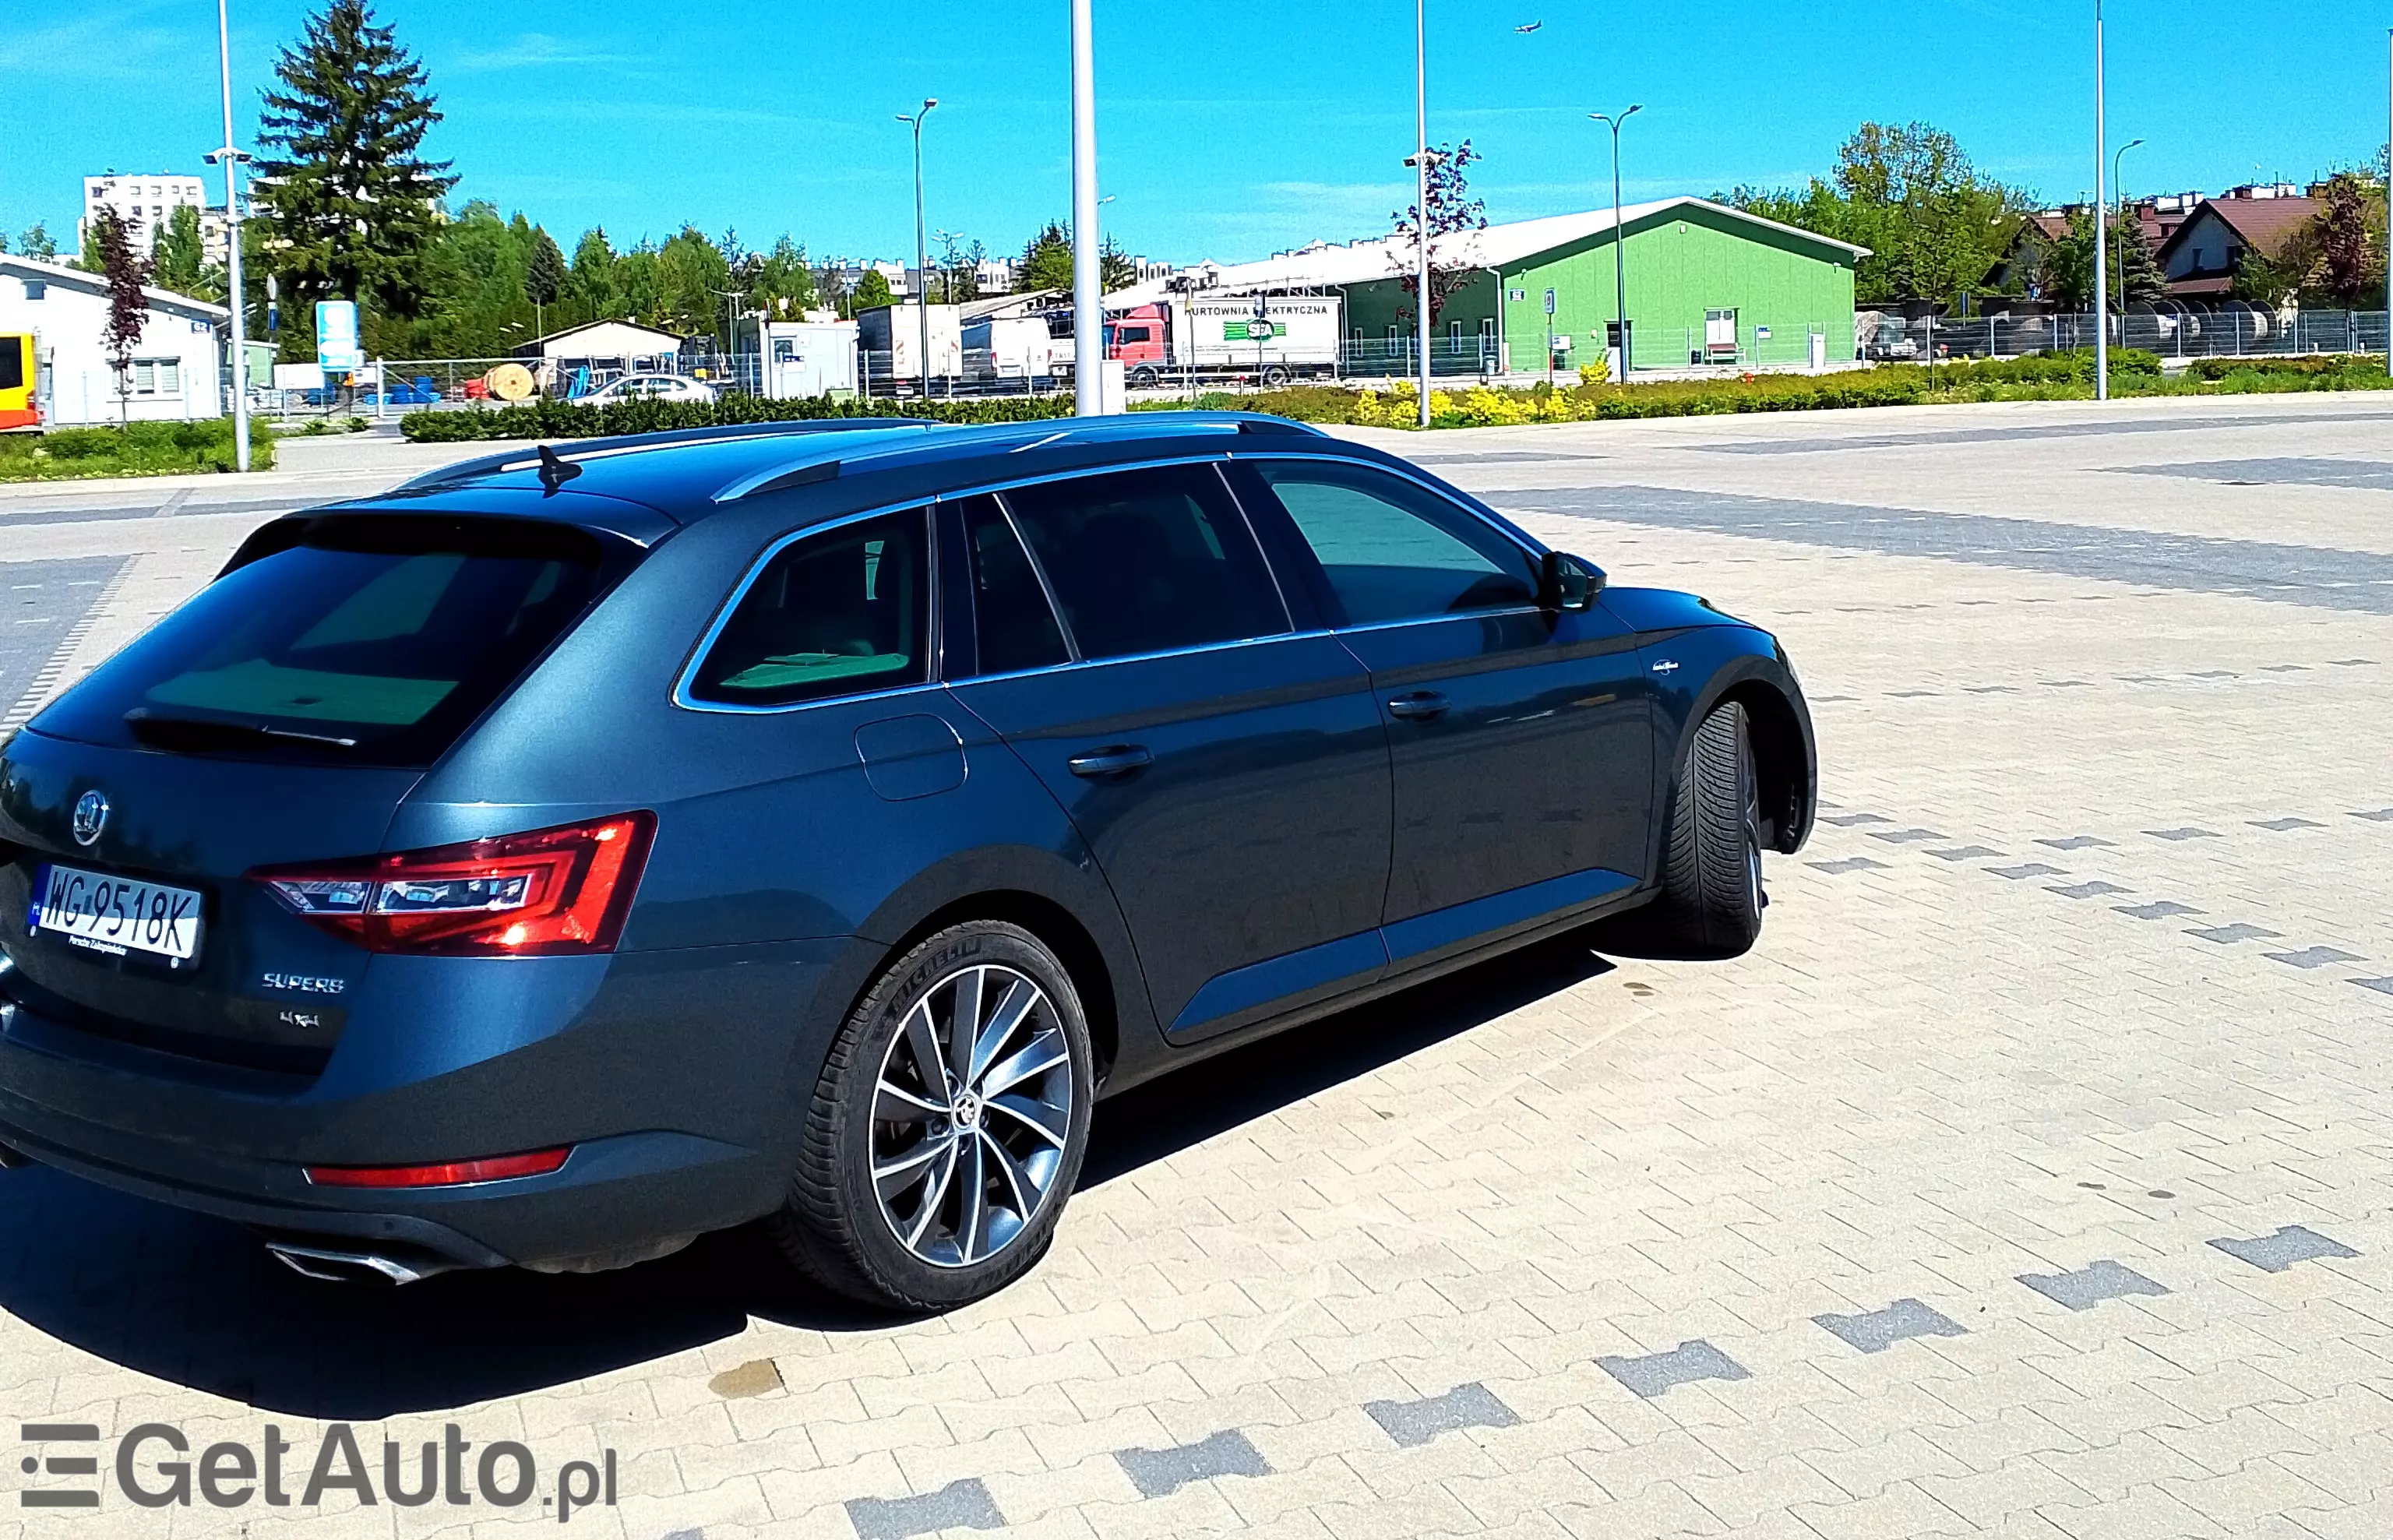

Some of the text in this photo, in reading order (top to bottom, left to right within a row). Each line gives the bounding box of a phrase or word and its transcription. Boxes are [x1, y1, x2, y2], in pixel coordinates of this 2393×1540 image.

[1253, 306, 1327, 315] EKTRYCZNA
[88, 880, 192, 952] 9518K
[262, 973, 344, 993] SUPERB
[890, 937, 982, 1012] MICHELIN
